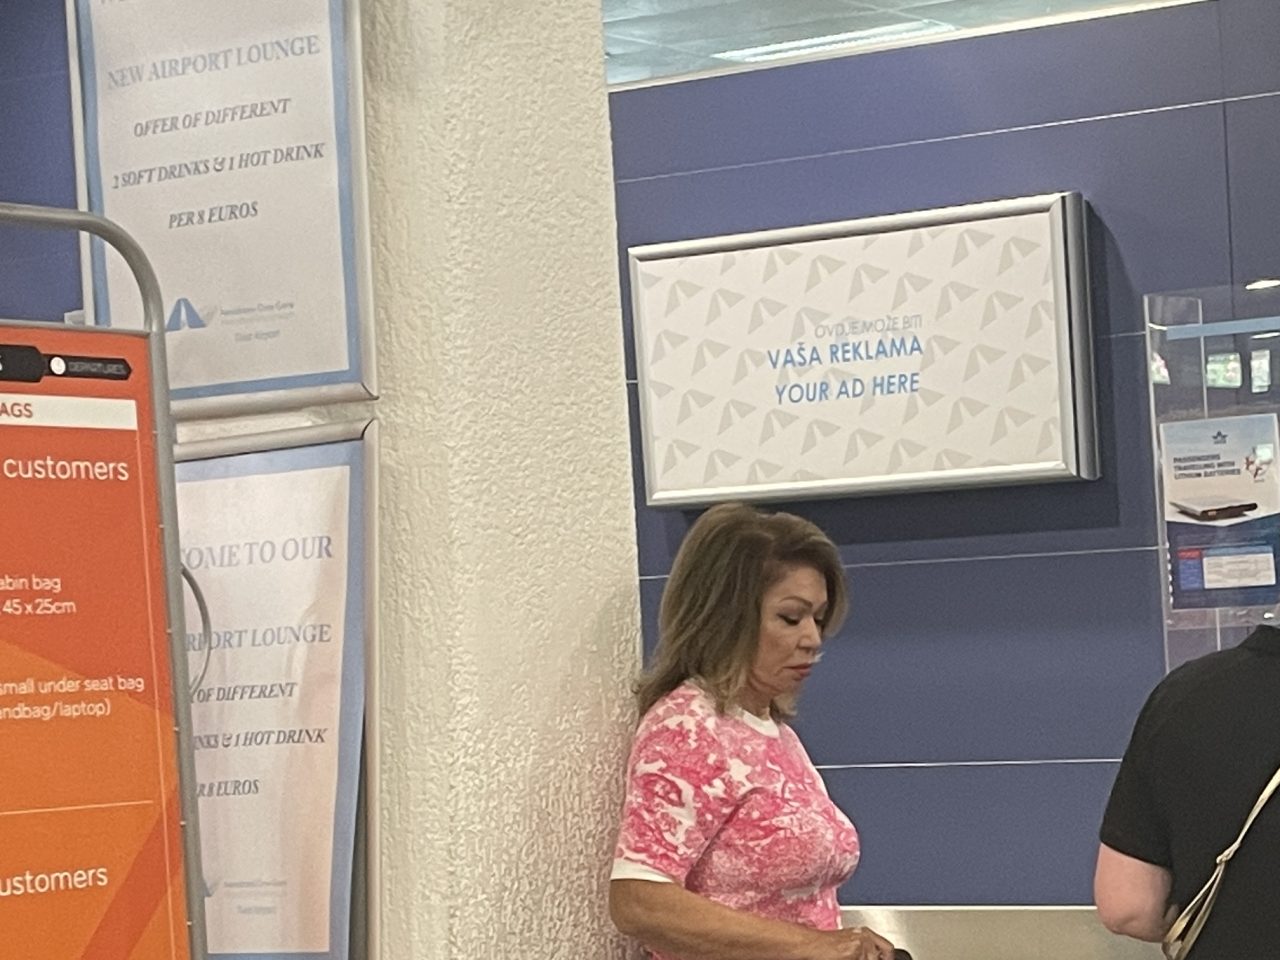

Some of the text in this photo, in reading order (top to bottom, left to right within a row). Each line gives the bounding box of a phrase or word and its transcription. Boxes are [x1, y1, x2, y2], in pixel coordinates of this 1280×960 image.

[107, 35, 321, 90] NEW AIRPORT LOUNGE
[134, 98, 291, 137] OFFER OF DIFFERENT
[112, 142, 325, 189] 2 SOFT DRINKS & 1 HOT DRINK
[168, 201, 259, 229] PER 8 EUROS
[767, 335, 923, 370] VAŠA REKLAMA
[775, 372, 920, 405] YOUR AD HERE
[3, 456, 129, 480] customers
[244, 540, 276, 566] TO
[281, 535, 333, 562] OUR
[32, 573, 61, 593] bag
[2, 598, 77, 615] 45 x 25cm
[251, 624, 332, 648] LOUNGE
[38, 676, 81, 693] under
[84, 676, 114, 691] seat
[117, 675, 145, 692] bag
[197, 686, 215, 703] OF
[216, 682, 297, 702] DIFFERENT
[242, 730, 276, 747] HOT
[276, 728, 328, 746] DRINK
[216, 779, 260, 797] EUROS
